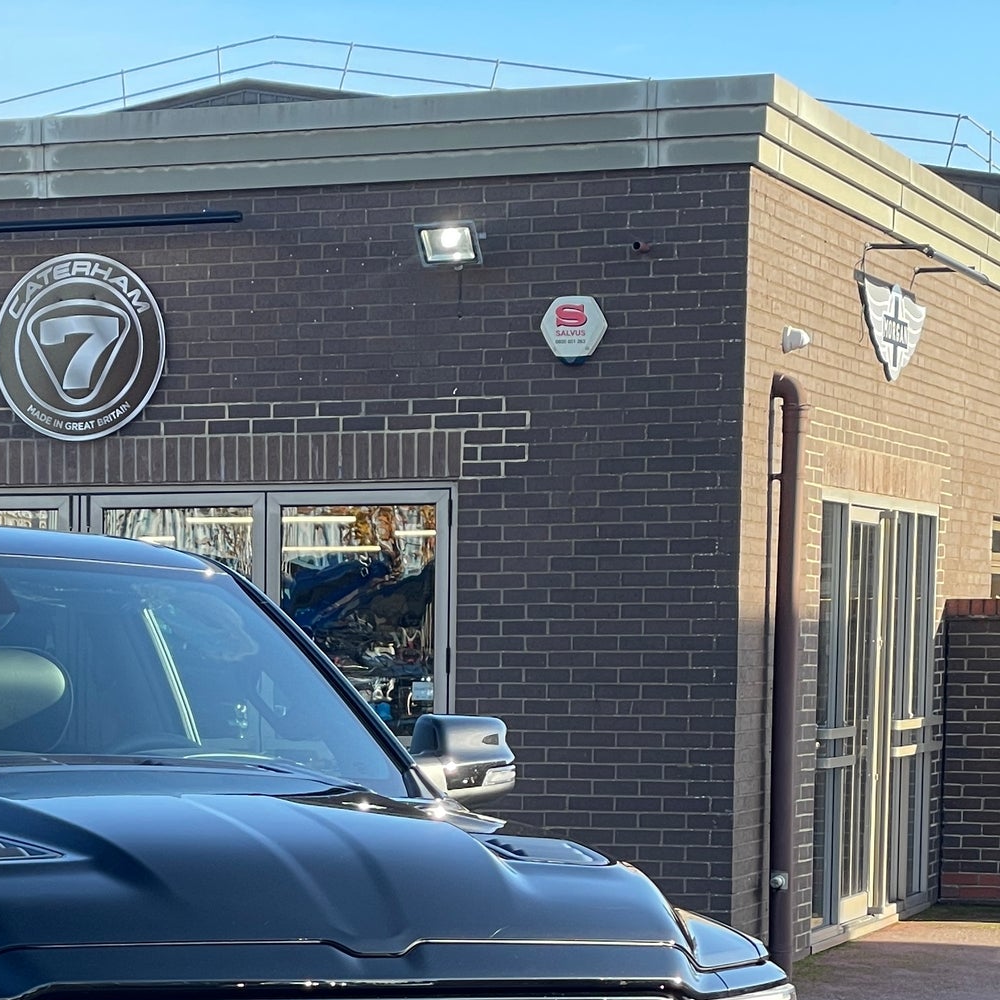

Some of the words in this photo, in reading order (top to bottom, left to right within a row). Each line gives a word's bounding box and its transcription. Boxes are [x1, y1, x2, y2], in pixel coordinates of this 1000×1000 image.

[8, 260, 151, 320] CATERHAM
[40, 315, 119, 390] 7
[27, 404, 53, 425] MADE
[54, 420, 63, 429] IN
[65, 420, 95, 431] GREAT
[97, 401, 131, 427] BRITAIN
